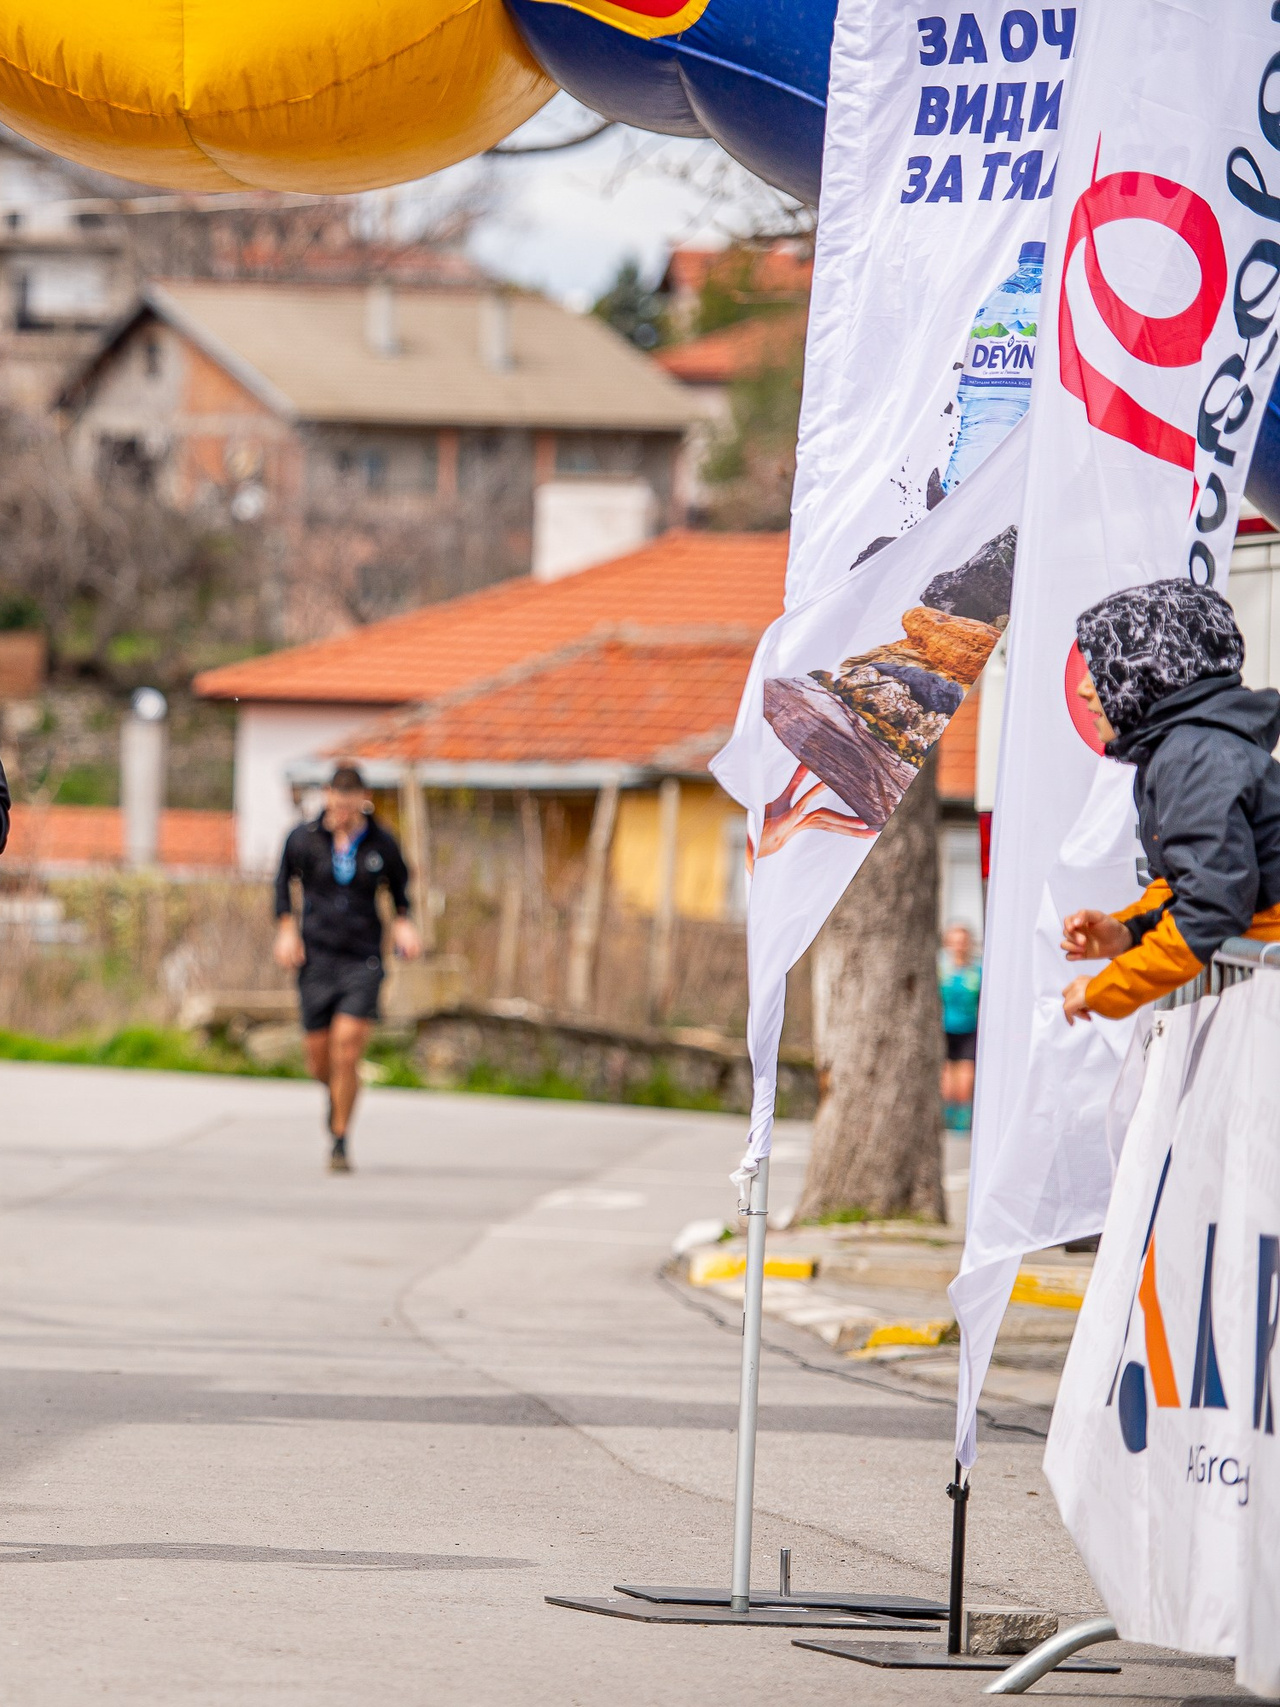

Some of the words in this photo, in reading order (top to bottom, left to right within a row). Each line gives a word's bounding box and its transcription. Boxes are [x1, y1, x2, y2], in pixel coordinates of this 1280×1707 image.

[917, 13, 988, 66] ЗА
[900, 155, 962, 204] ЗА
[972, 344, 1036, 369] DEVIN
